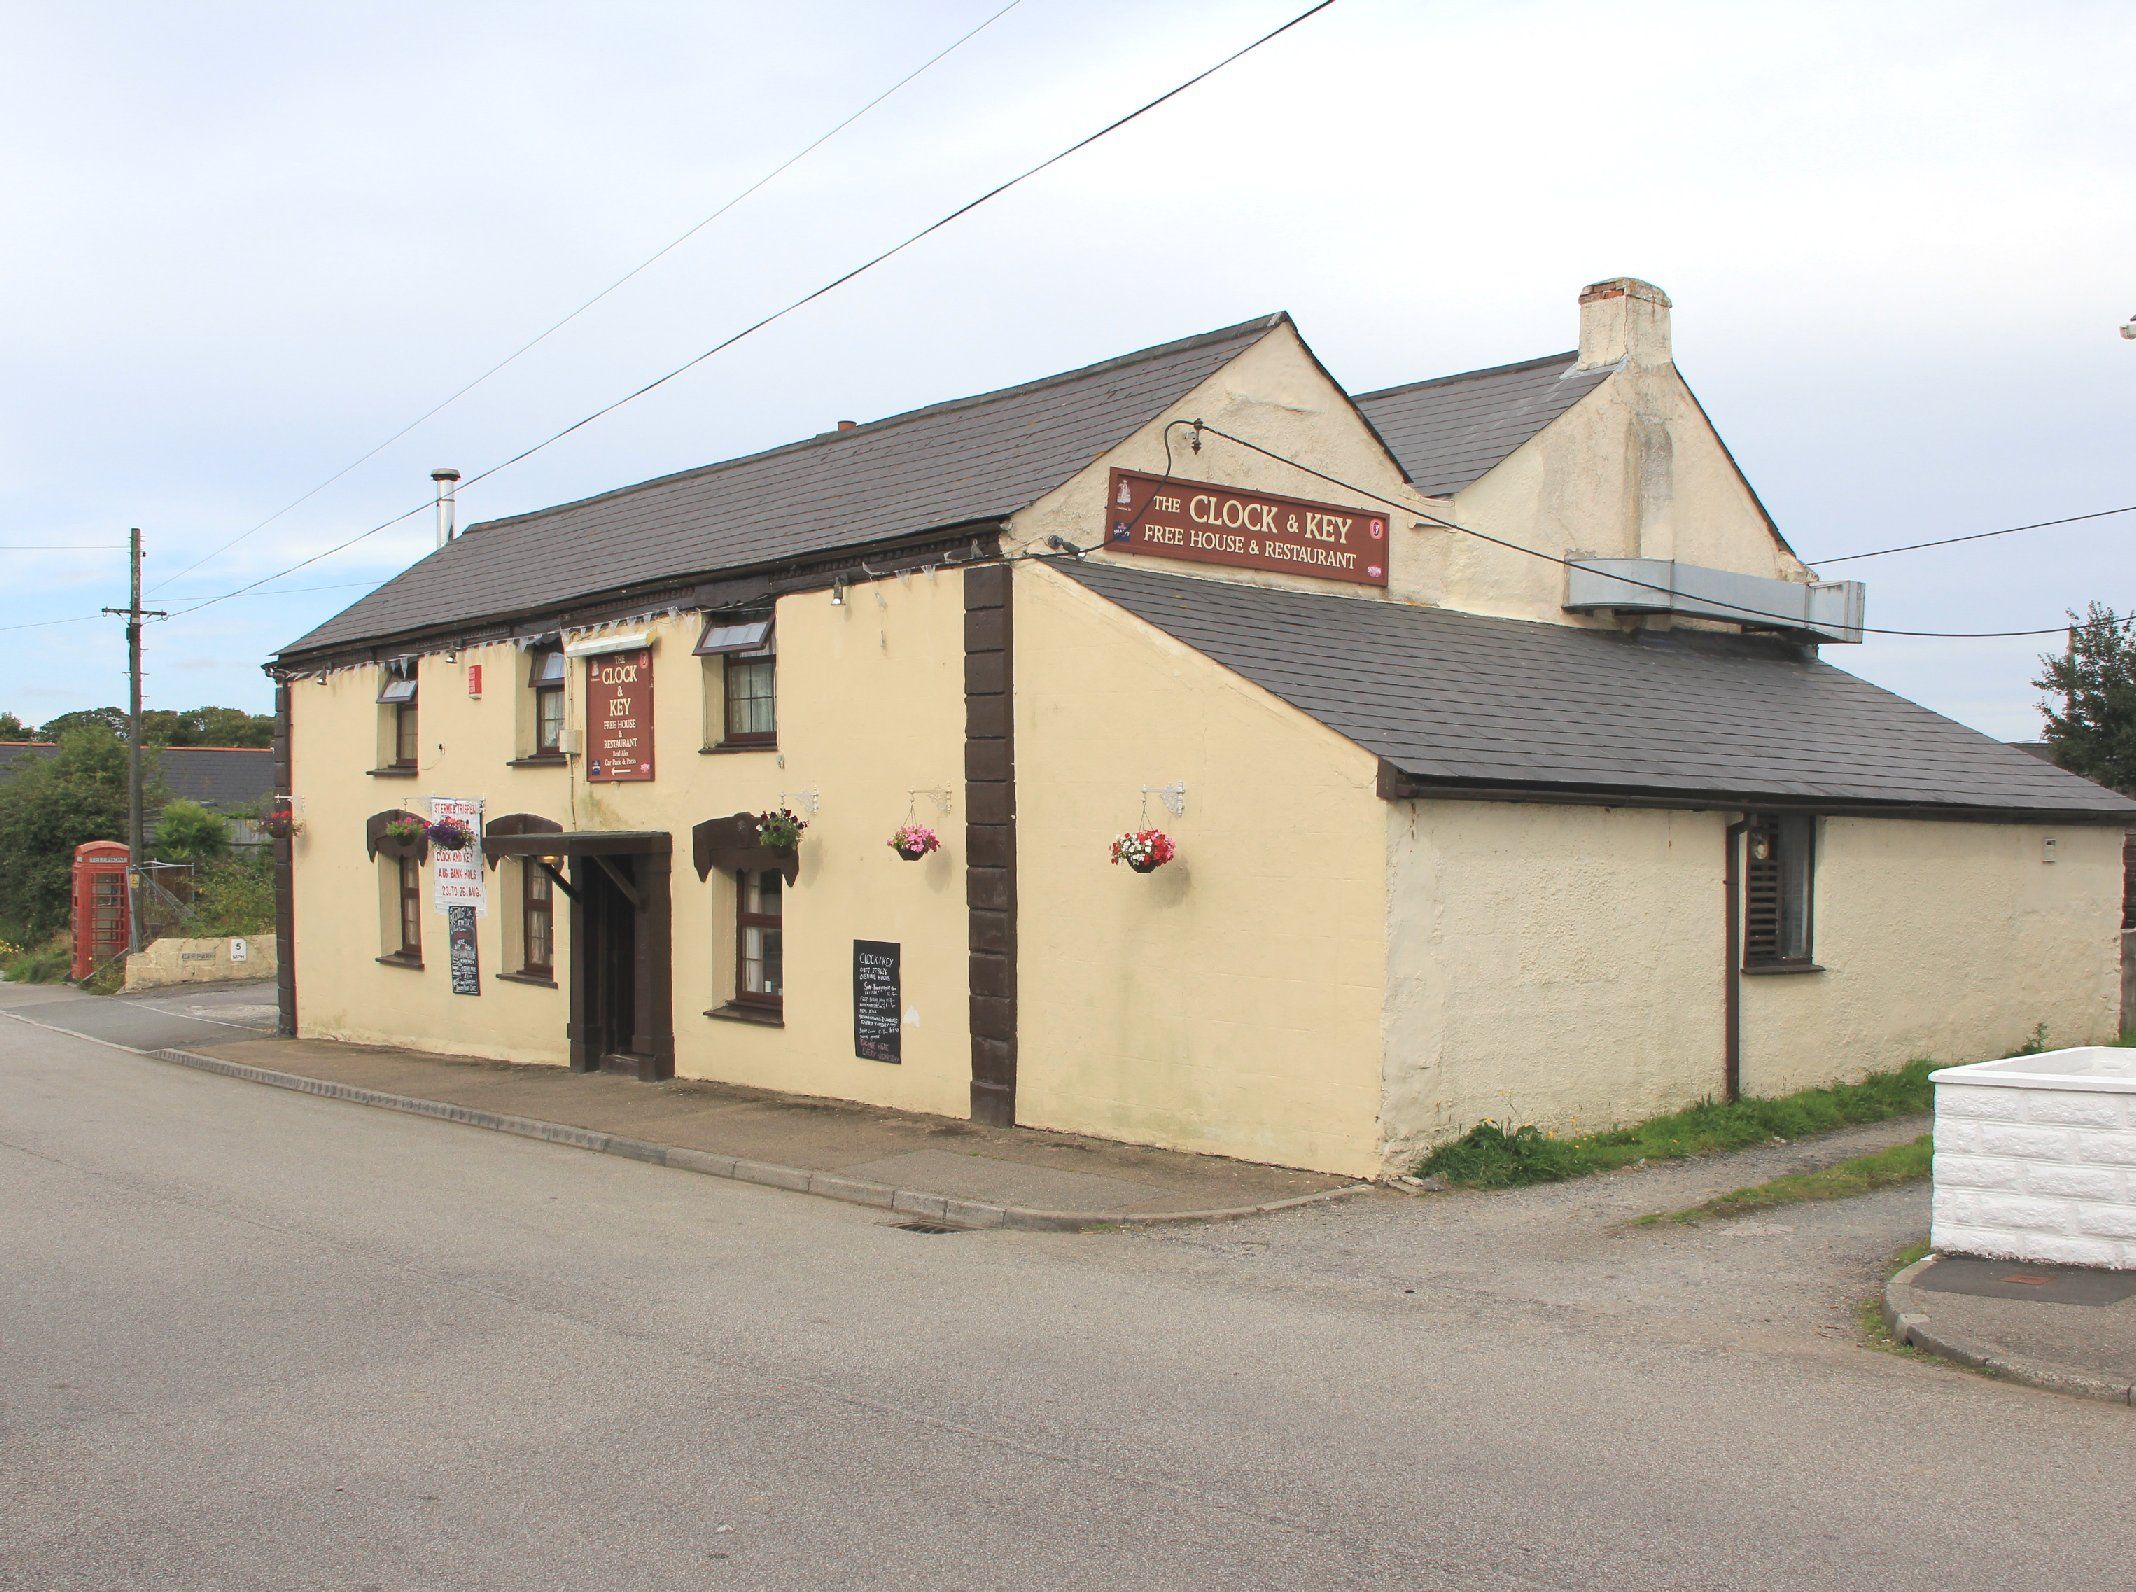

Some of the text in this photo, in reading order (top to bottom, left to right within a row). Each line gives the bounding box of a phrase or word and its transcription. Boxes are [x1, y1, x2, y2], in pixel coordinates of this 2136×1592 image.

[1153, 495, 1352, 544] THE CLOCK & KEY
[1143, 524, 1357, 570] FREE HOUSE & RESTAURANT
[614, 655, 626, 664] THE
[602, 665, 638, 685] CLOCK
[617, 685, 623, 697] &
[609, 698, 632, 717] KEY
[603, 718, 636, 730] FREE HOUSE
[604, 738, 638, 749] RESTAURANT
[235, 942, 242, 951] 5
